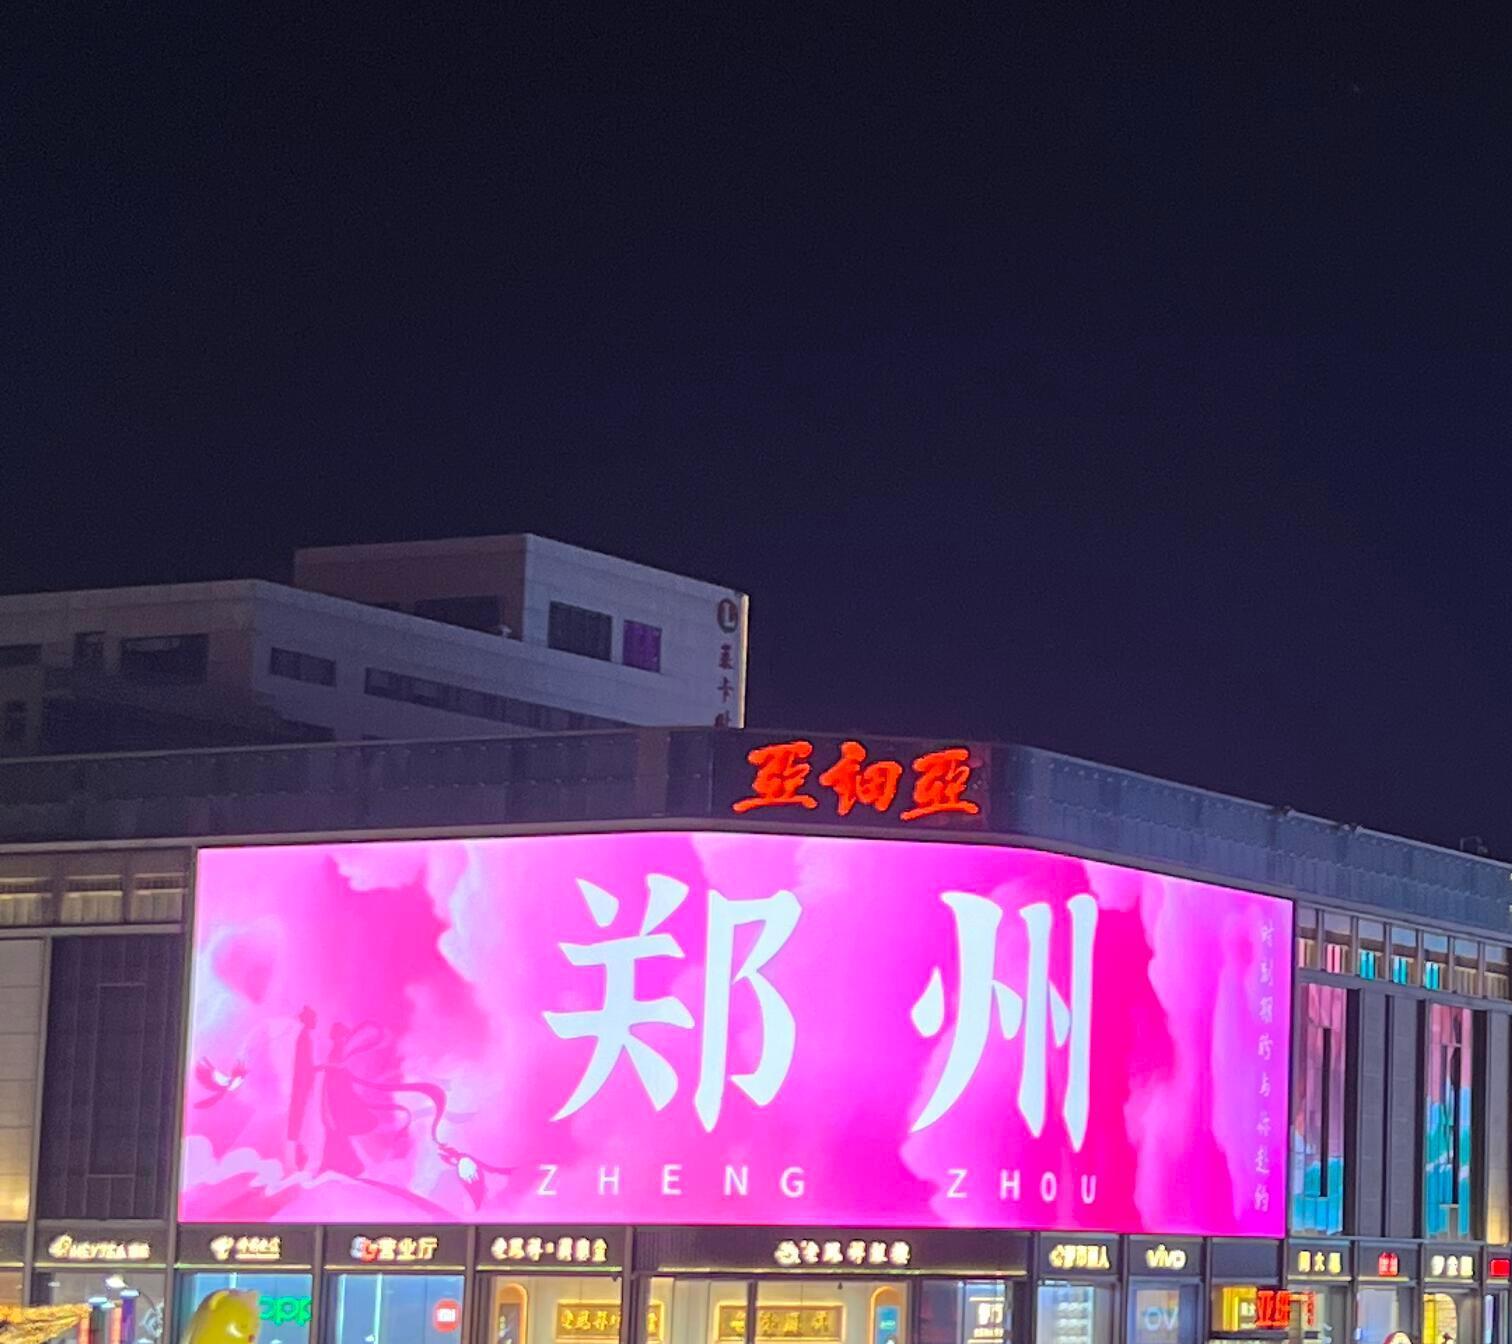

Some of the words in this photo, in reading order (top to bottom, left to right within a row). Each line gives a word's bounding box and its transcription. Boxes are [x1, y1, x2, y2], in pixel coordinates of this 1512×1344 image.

[541, 872, 1099, 1154] 郑州
[377, 1236, 438, 1261] 营业厅
[1145, 1243, 1187, 1270] vivo
